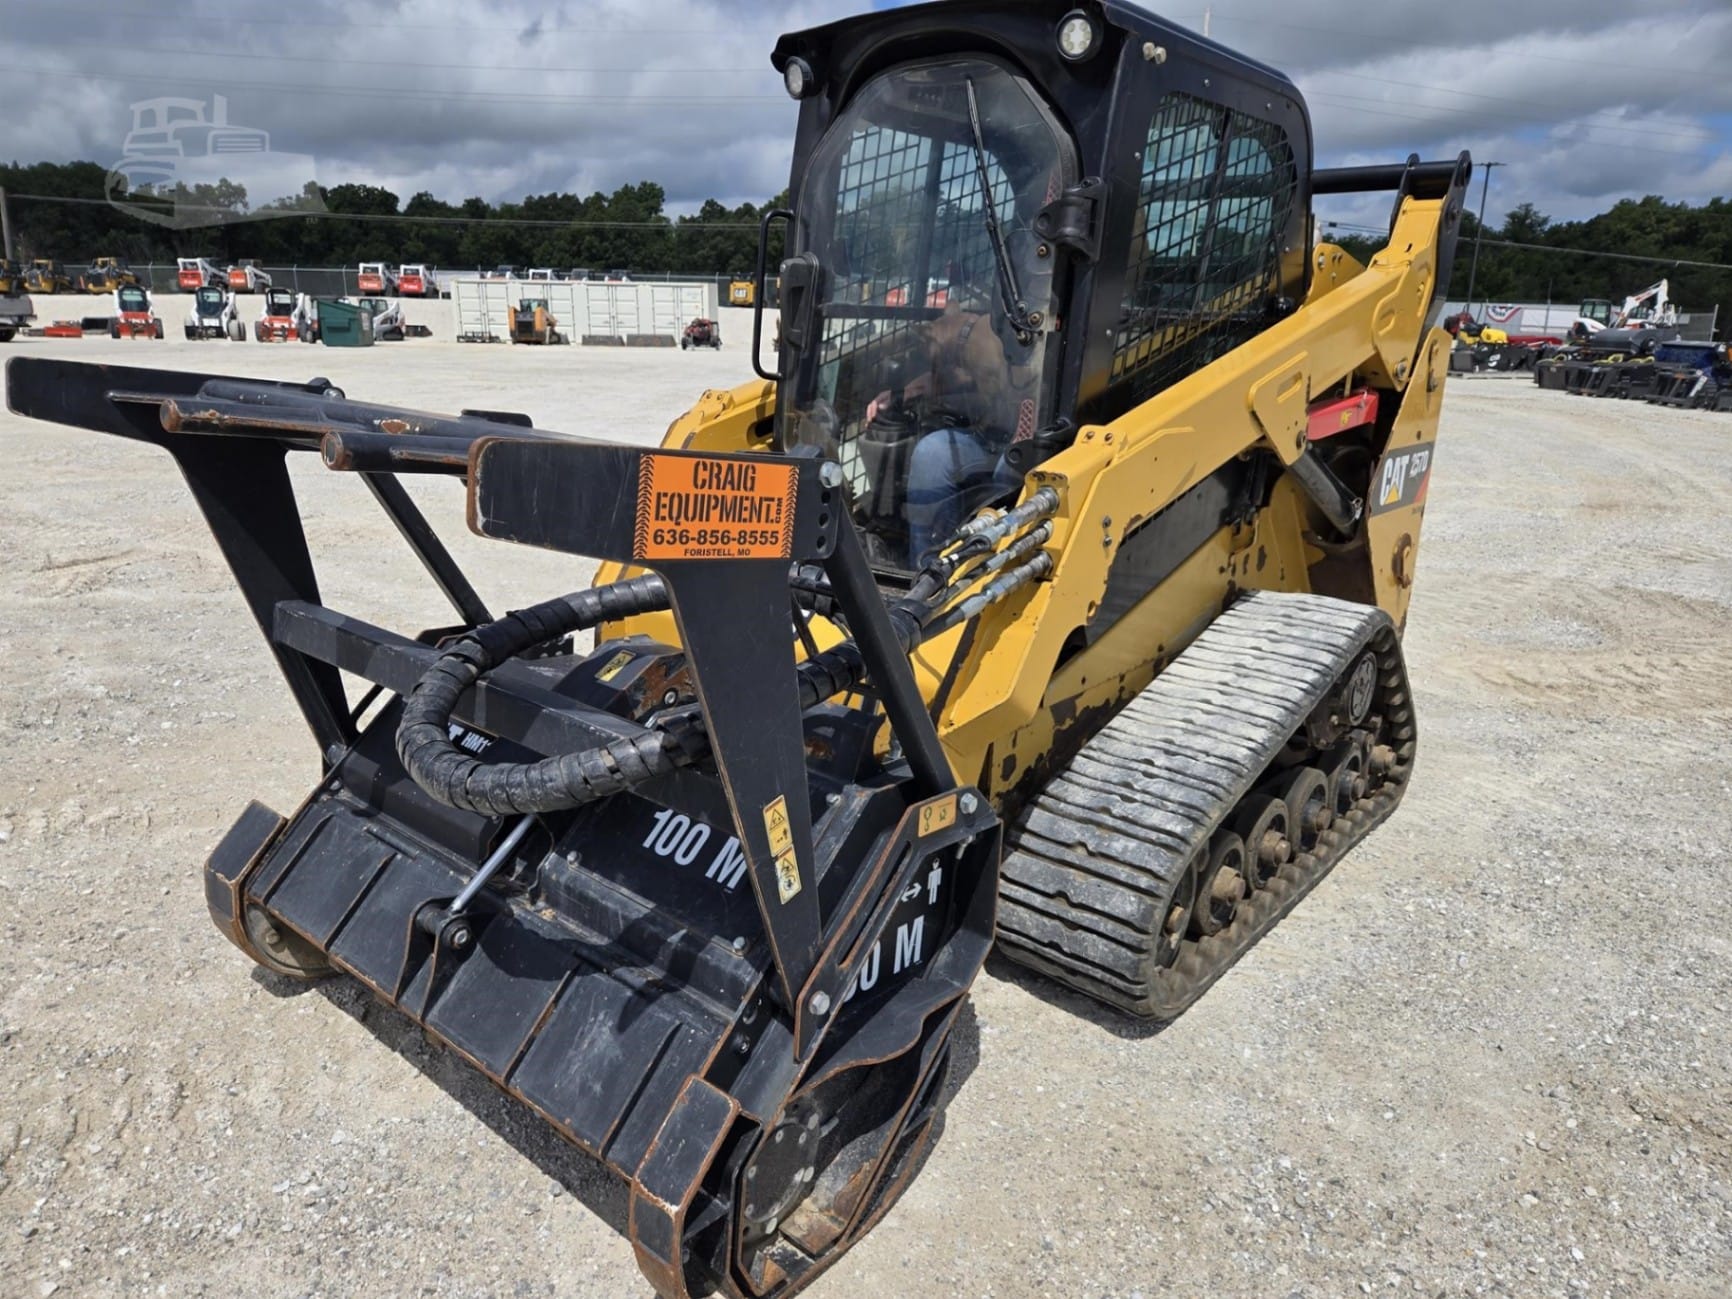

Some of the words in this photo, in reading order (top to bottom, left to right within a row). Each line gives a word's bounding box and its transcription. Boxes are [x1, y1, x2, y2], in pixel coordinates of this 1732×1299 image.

[693, 461, 756, 493] CRAIG
[1380, 456, 1410, 506] CAT
[653, 529, 779, 546] 636-856-8555
[684, 548, 735, 557] FORISTELL,
[738, 548, 751, 557] MO
[642, 808, 711, 866] 100
[704, 835, 748, 890] M
[893, 915, 925, 974] M
